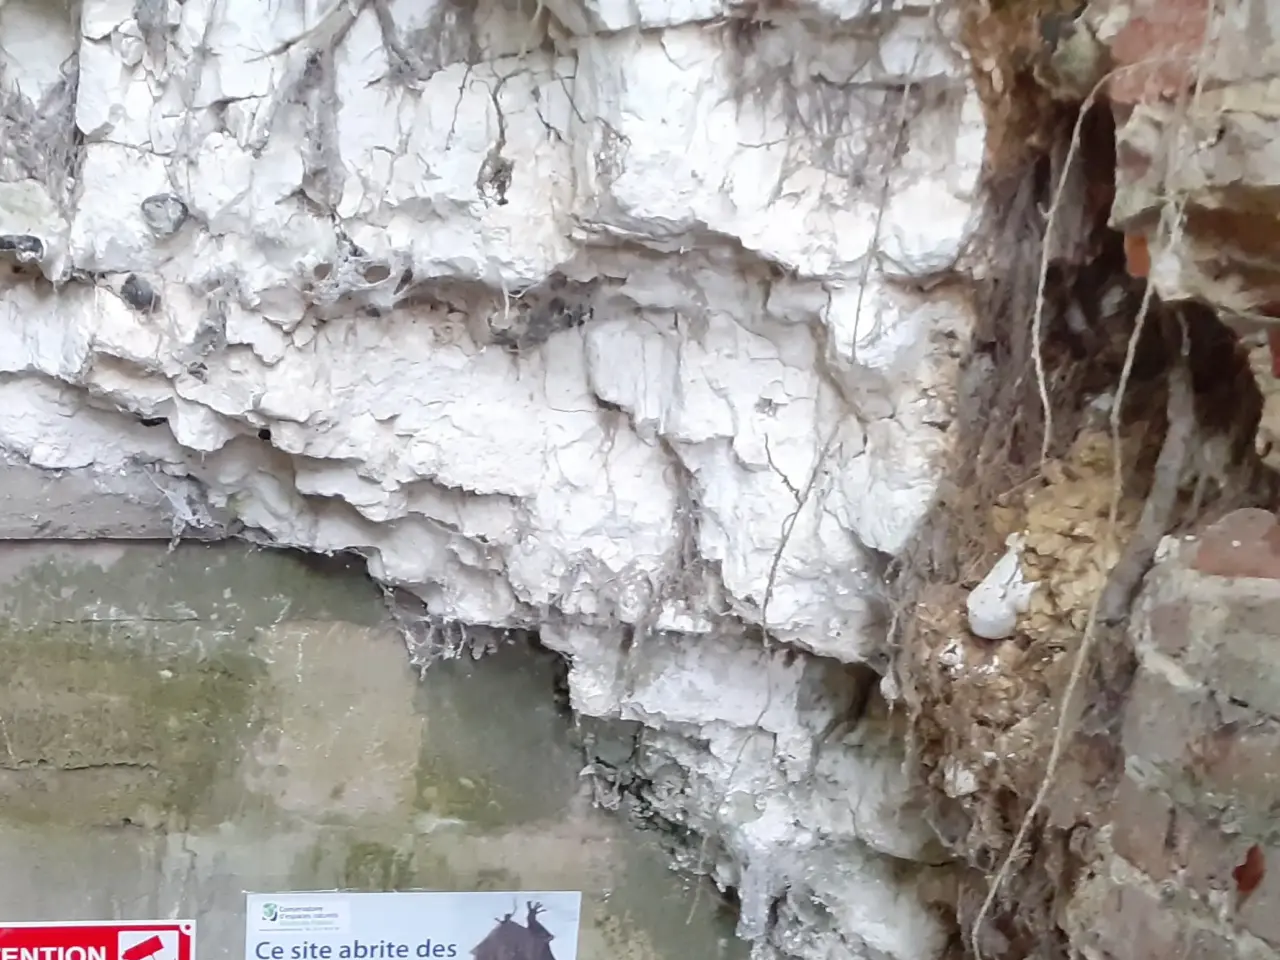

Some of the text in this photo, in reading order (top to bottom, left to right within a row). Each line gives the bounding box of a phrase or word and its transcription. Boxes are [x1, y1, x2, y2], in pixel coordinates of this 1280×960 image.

[255, 938, 457, 960] Ce site abrite des
